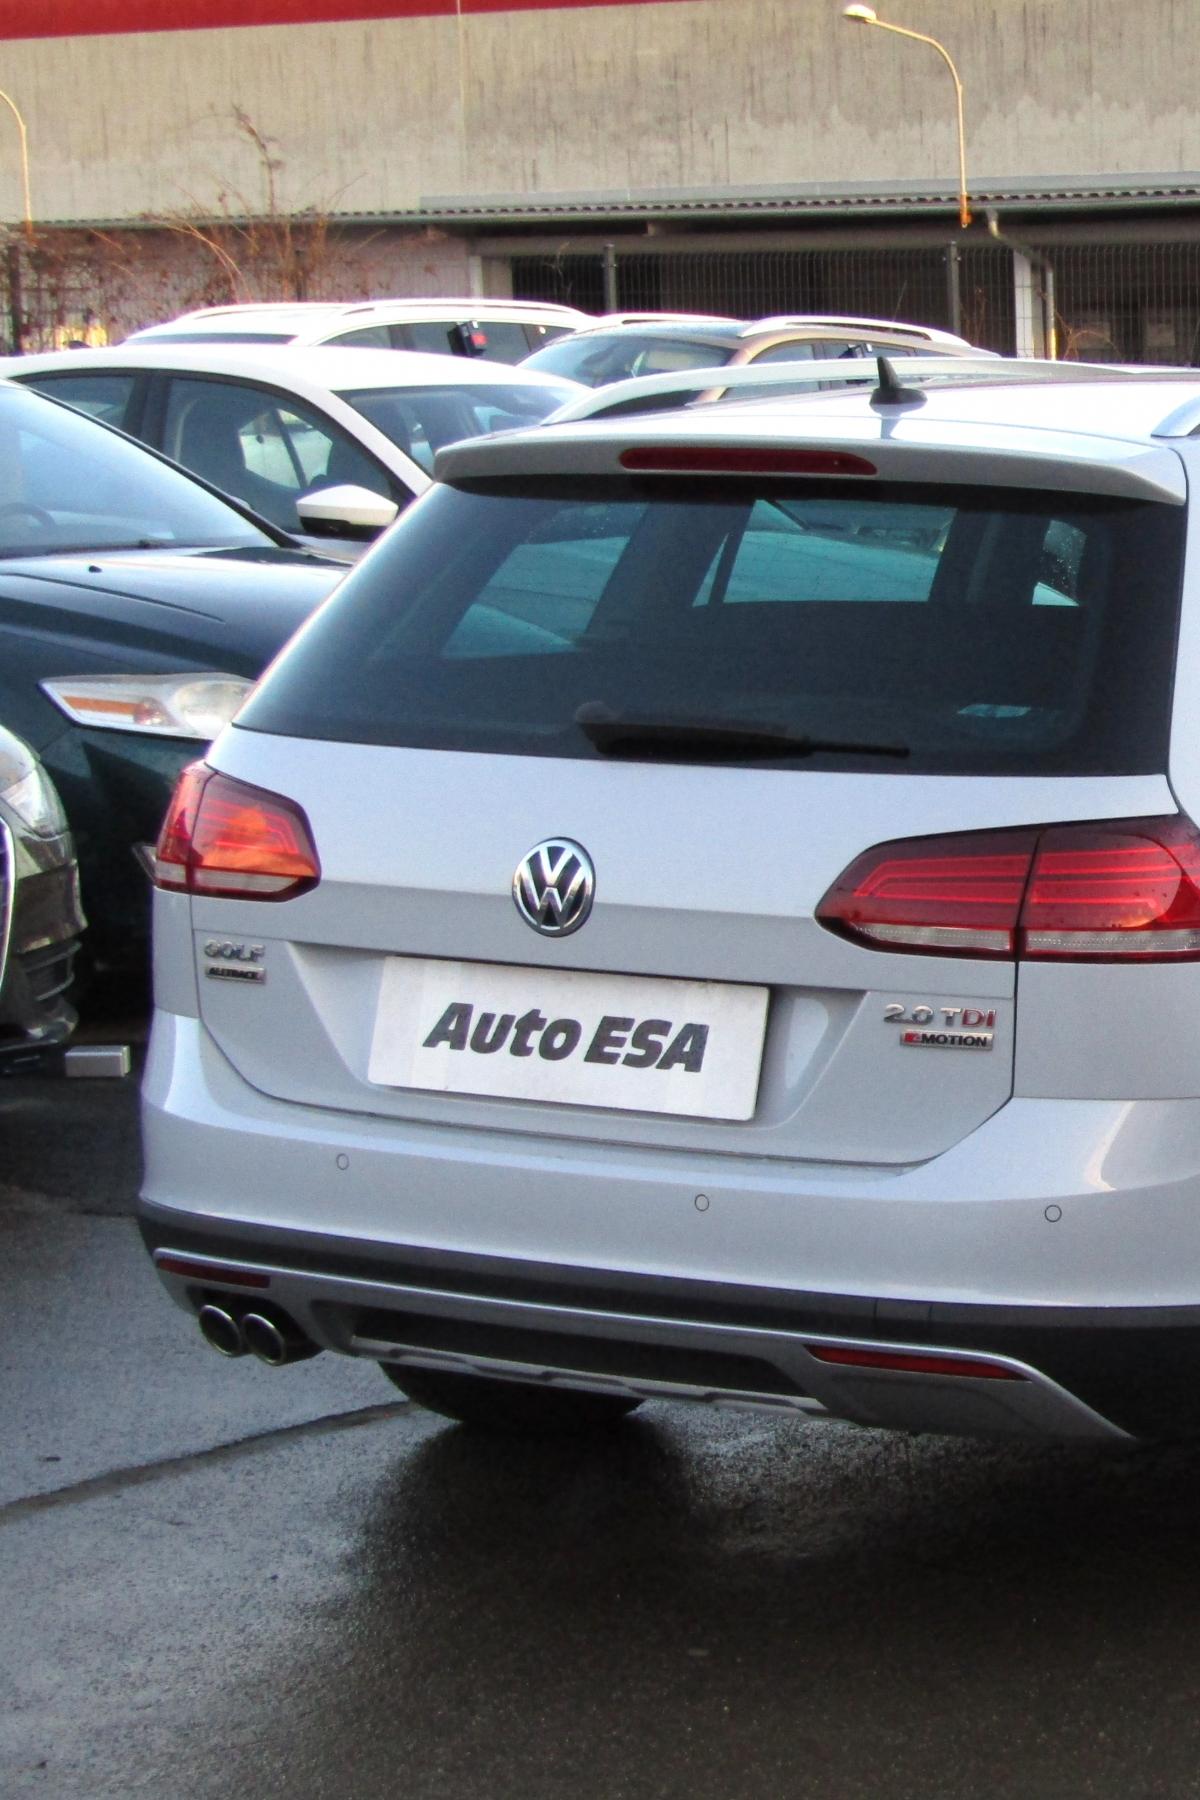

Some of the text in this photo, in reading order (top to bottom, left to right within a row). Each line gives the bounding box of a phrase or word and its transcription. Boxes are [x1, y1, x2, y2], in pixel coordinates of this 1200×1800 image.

[204, 939, 265, 961] GOLF
[422, 1002, 710, 1073] Auto ESA
